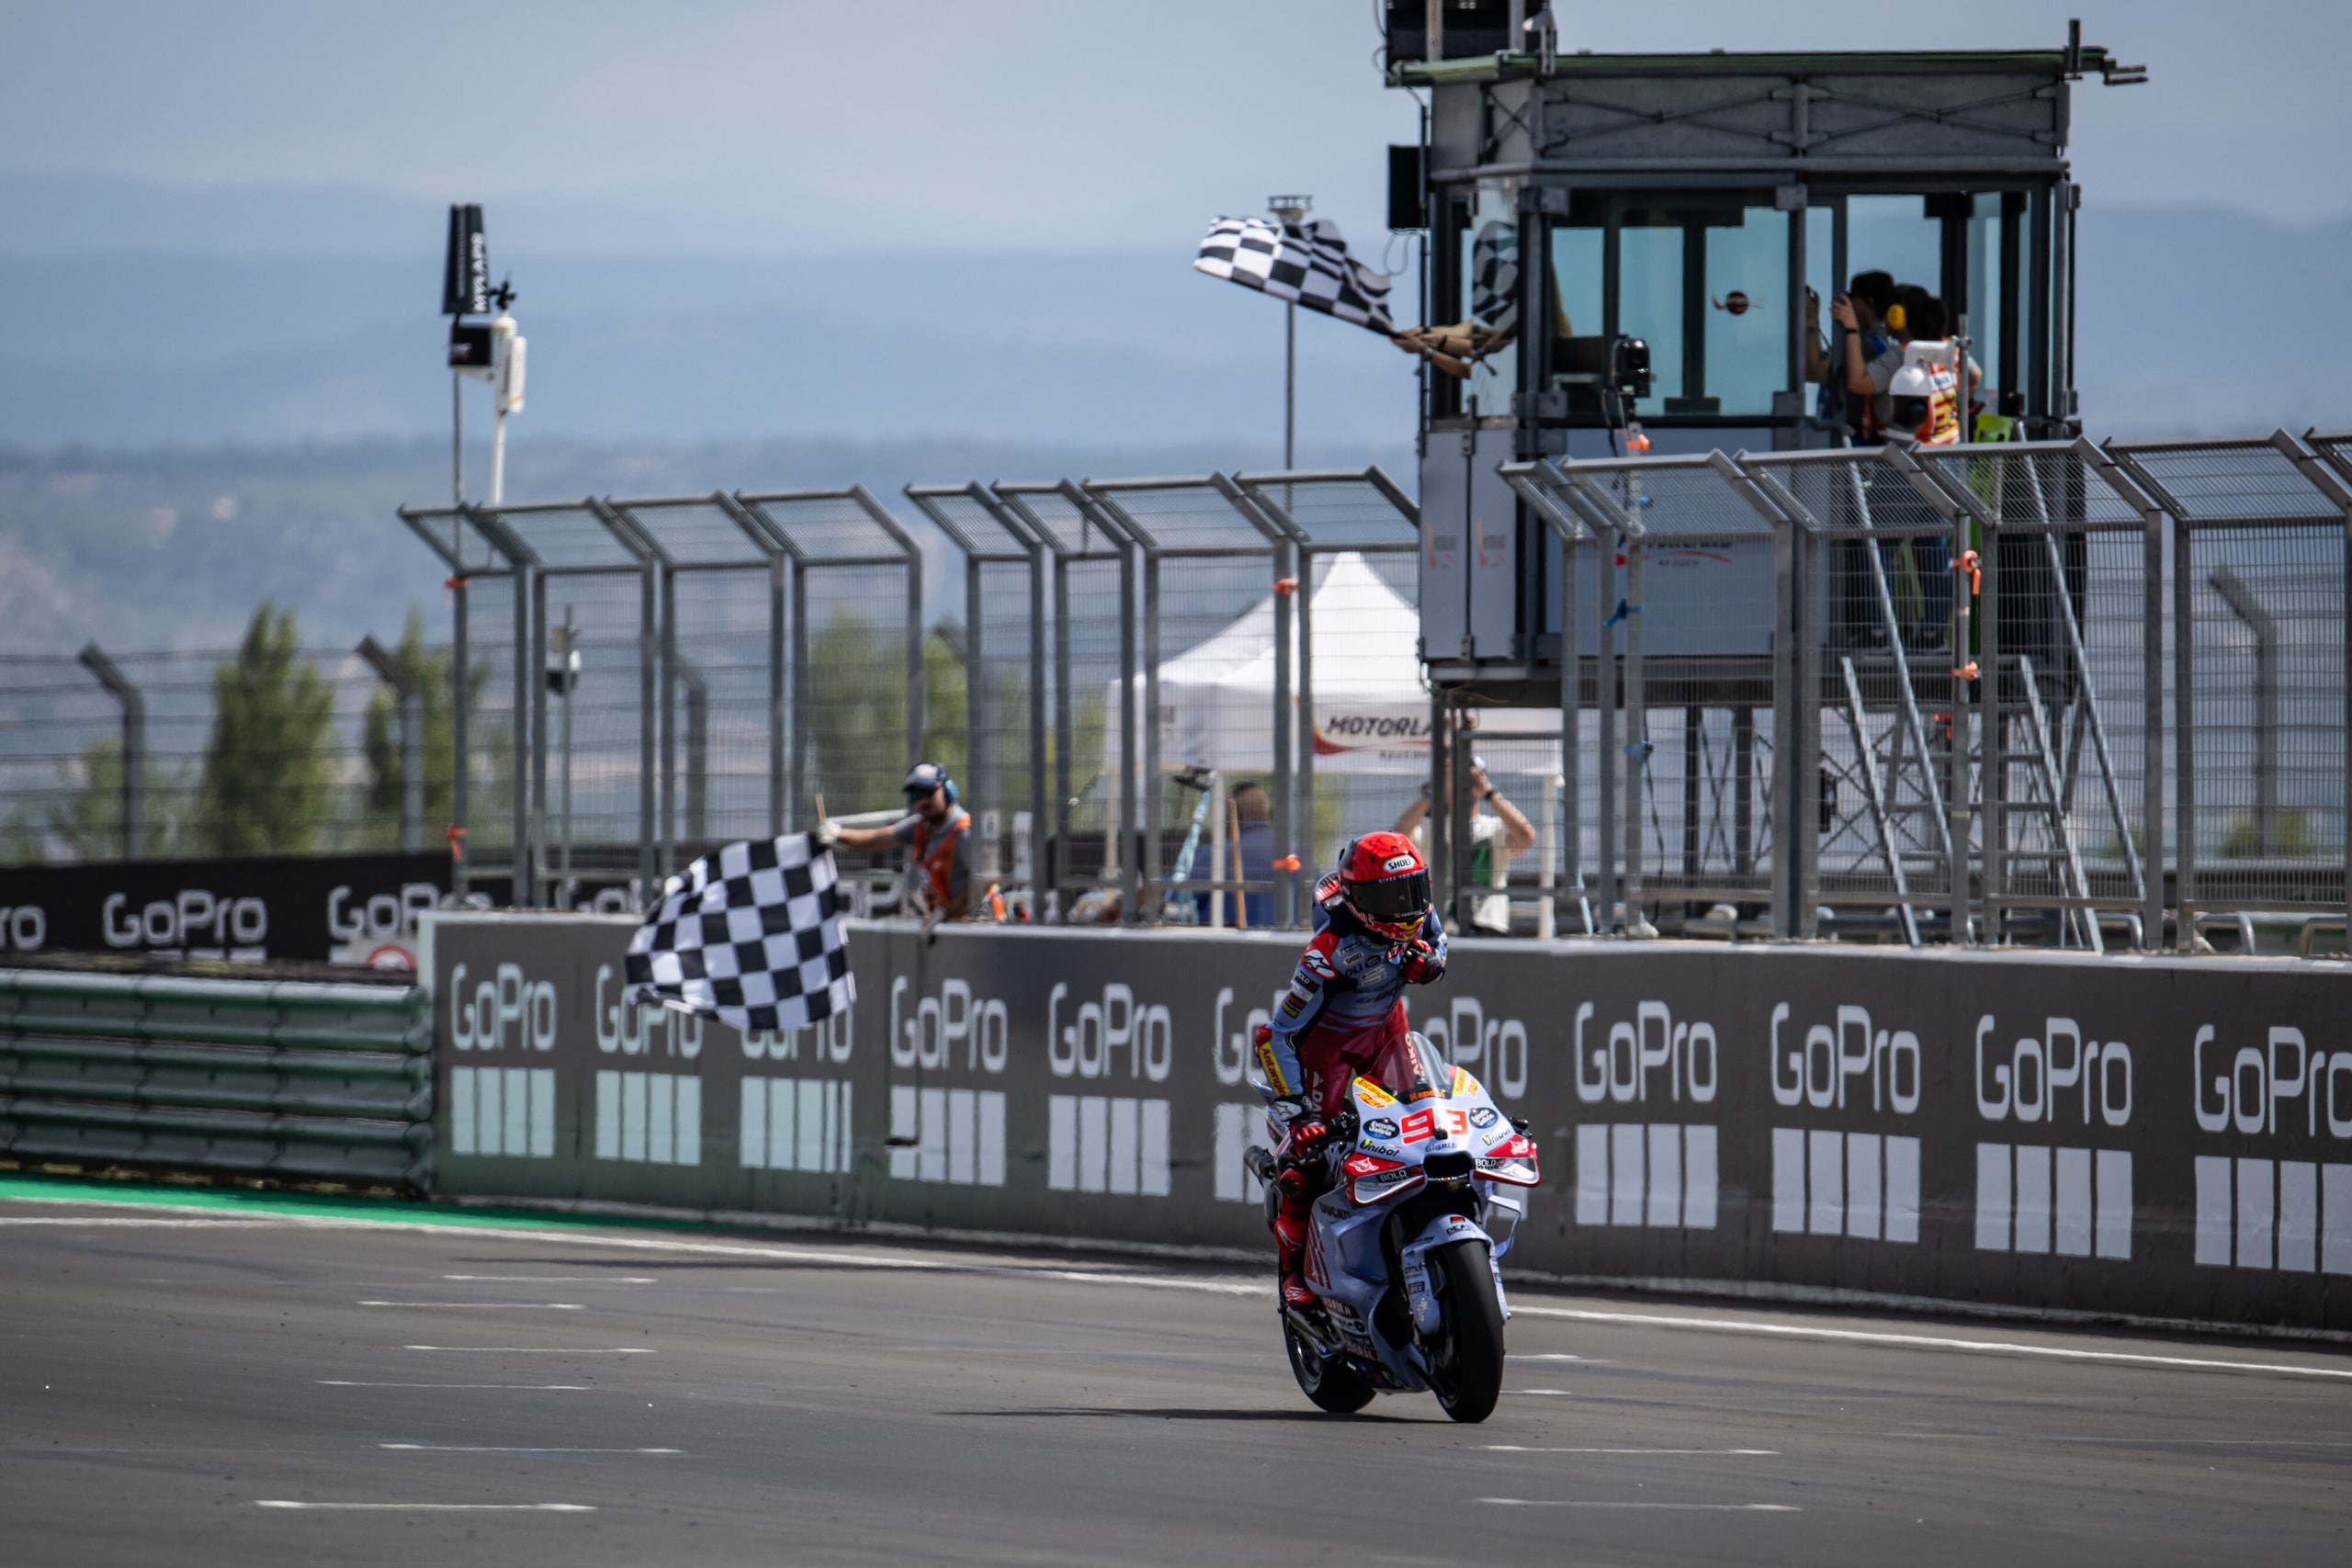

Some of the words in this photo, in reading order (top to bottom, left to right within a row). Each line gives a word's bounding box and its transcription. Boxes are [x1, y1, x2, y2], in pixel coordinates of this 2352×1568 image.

[103, 891, 267, 948] GoPro
[450, 962, 558, 1051] GoPro
[890, 976, 1008, 1074] GoPro
[1047, 982, 1171, 1082] GoPro
[1575, 1000, 1717, 1103] GoPro
[1770, 1002, 1921, 1114] GoPro
[1975, 1014, 2132, 1127] GoPro
[2194, 1023, 2352, 1138] GoPro
[1360, 1138, 1400, 1157] Unibat
[1399, 1106, 1469, 1145] 93
[1475, 1158, 1497, 1168] BOLD
[1318, 1201, 1351, 1220] DUCATI
[1379, 1169, 1408, 1182] BOLD
